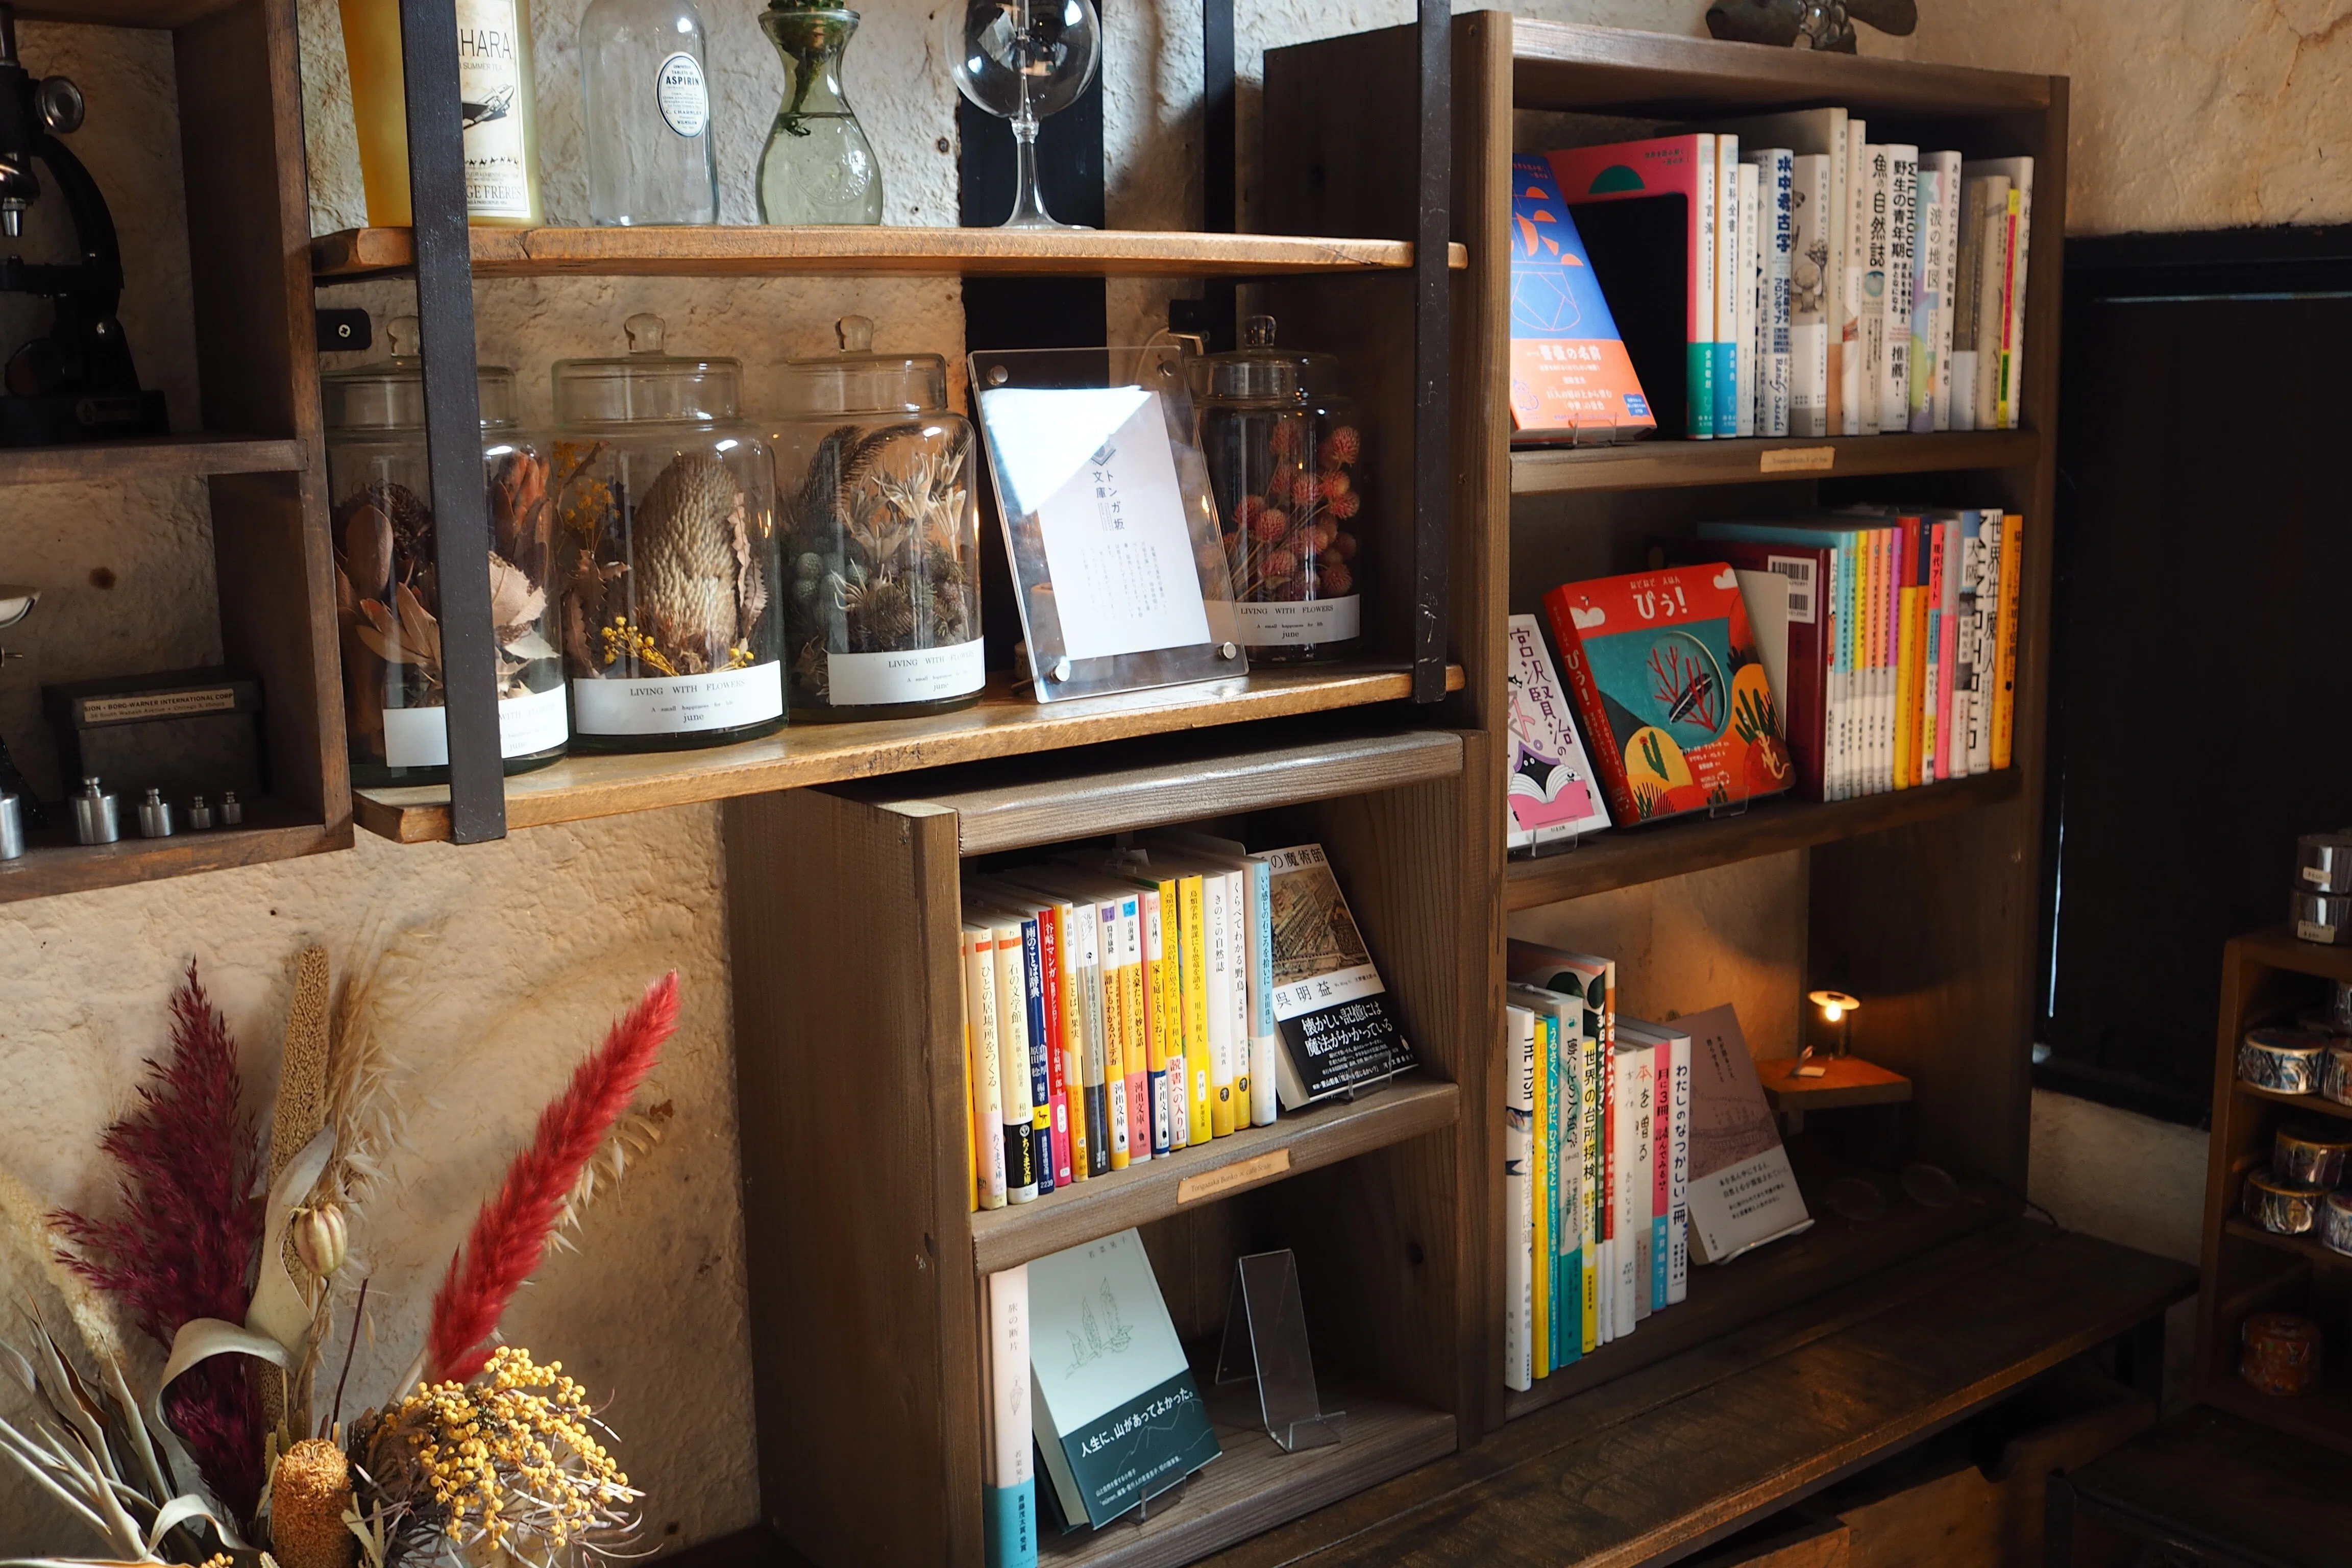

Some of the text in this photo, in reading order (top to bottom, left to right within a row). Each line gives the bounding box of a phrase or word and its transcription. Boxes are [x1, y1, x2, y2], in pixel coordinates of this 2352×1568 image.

[458, 29, 511, 59] HARA
[463, 62, 491, 70] SUMMER
[666, 76, 699, 86] ASPIRIN
[1728, 170, 1736, 233] 百科全書
[1777, 155, 1793, 254] 水中考古学
[1870, 153, 1888, 266] 魚の自然誌
[1891, 160, 1907, 258] 野生の青年期
[1906, 161, 1918, 259] WILDHOOD
[1539, 344, 1601, 361] 薔薇の名前
[1770, 358, 1785, 432] Randy Sasaki
[1092, 471, 1107, 499] 文庫
[1106, 470, 1125, 531] トンガ坂
[1931, 544, 1941, 601] 現代アート
[1302, 604, 1334, 613] FLOWERS
[1282, 631, 1300, 639] june
[888, 650, 974, 668] LIVING WITH FLOWERS
[108, 699, 158, 710] BORG-WARNER
[160, 695, 214, 705] INTERNATIONAL
[630, 679, 746, 697] LIVING WITH FLOWERS
[933, 682, 949, 691] june
[1509, 627, 1573, 756] 宮沢賢治の
[683, 713, 704, 723] june
[1261, 847, 1325, 869] の魔術師
[1044, 922, 1057, 978] 谷崎マンガ
[1190, 890, 1201, 991] 鳥類学者 無謀にも恐竜を語る
[1215, 894, 1225, 973] きのこの自然誌
[1233, 881, 1245, 992] くらべてわかる野鳥
[1260, 875, 1271, 985] いい感じの石ころを拾いに
[1025, 925, 1040, 999] 雨のことば辞典
[1009, 962, 1022, 1024] 石の文学館
[1069, 977, 1080, 1038] ことばの果実
[1133, 967, 1144, 1048] 文豪たちの妙な話
[1153, 964, 1163, 1044] 家と庭と犬とねこ
[1276, 980, 1333, 1009] 呉明益
[981, 965, 997, 1087] ひとの居場所をつくる
[1170, 1004, 1180, 1047] 川上和人
[1194, 1000, 1203, 1043] 川上和人
[1302, 1000, 1383, 1037] 懐かしい記憶には
[1304, 1018, 1393, 1058] 魔法がかかっている
[1030, 1046, 1040, 1077] 原田稔
[1053, 1048, 1063, 1088] 谷崎潤一郎
[1523, 1067, 1534, 1100] FISH
[990, 1103, 998, 1112] 西
[1019, 1103, 1026, 1118] 和田
[1037, 1082, 1045, 1101] 編著
[1114, 1083, 1125, 1127] 河出文庫
[1135, 1080, 1145, 1125] 河出文庫
[1159, 1080, 1168, 1123] 河出文庫
[1170, 1058, 1185, 1142] 読書への入り口
[1548, 1026, 1558, 1187] うるさく、しずかに、ひそひそと
[1566, 1038, 1578, 1148] 働くことの人類学
[1583, 1048, 1597, 1180] 世界の台所探検
[1635, 1063, 1652, 1162] 本を贈る
[993, 1133, 1002, 1180] ちくま文庫
[1022, 1137, 1032, 1185] ちくま文庫
[1673, 1064, 1687, 1227] わたしのなつかしい一冊
[1040, 1179, 1054, 1189] 2239
[1191, 1179, 1220, 1192] Tongazaka
[1220, 1172, 1238, 1184] Bunko
[1258, 1162, 1272, 1172] Scale
[1008, 1302, 1019, 1352] 旅の断片
[1081, 1387, 1193, 1458] 人生に、山があってよかった。
[1095, 1467, 1137, 1498] 山と自然を愛する小冊子
